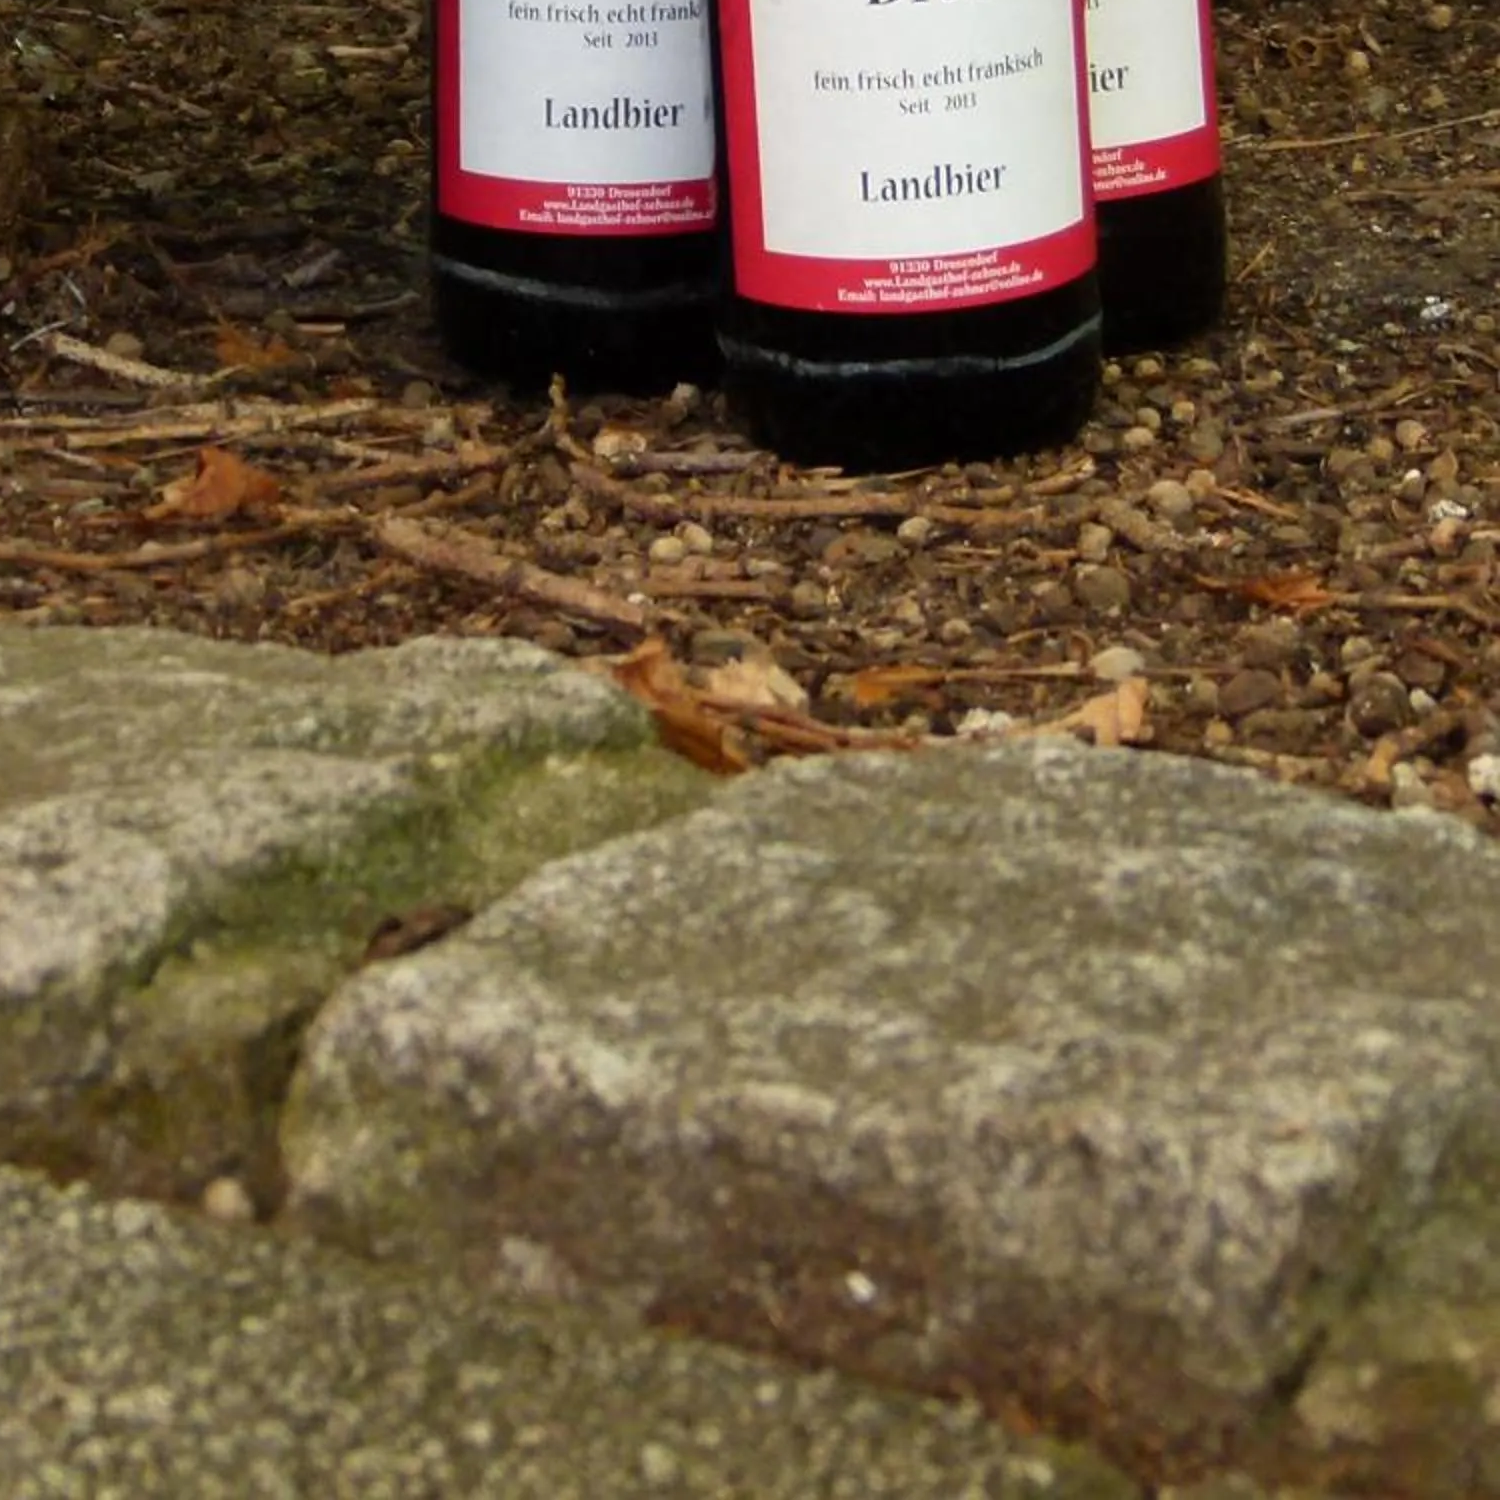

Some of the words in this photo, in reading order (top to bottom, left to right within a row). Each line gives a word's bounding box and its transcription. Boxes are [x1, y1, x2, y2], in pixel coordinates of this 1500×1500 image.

[607, 3, 645, 24] echt
[583, 31, 613, 49] Seit
[625, 31, 658, 49] 2013
[922, 65, 963, 88] echt
[545, 97, 685, 131] Landbier
[899, 99, 930, 115] Seit
[944, 92, 977, 112] 2013
[861, 163, 1007, 203] Landbier
